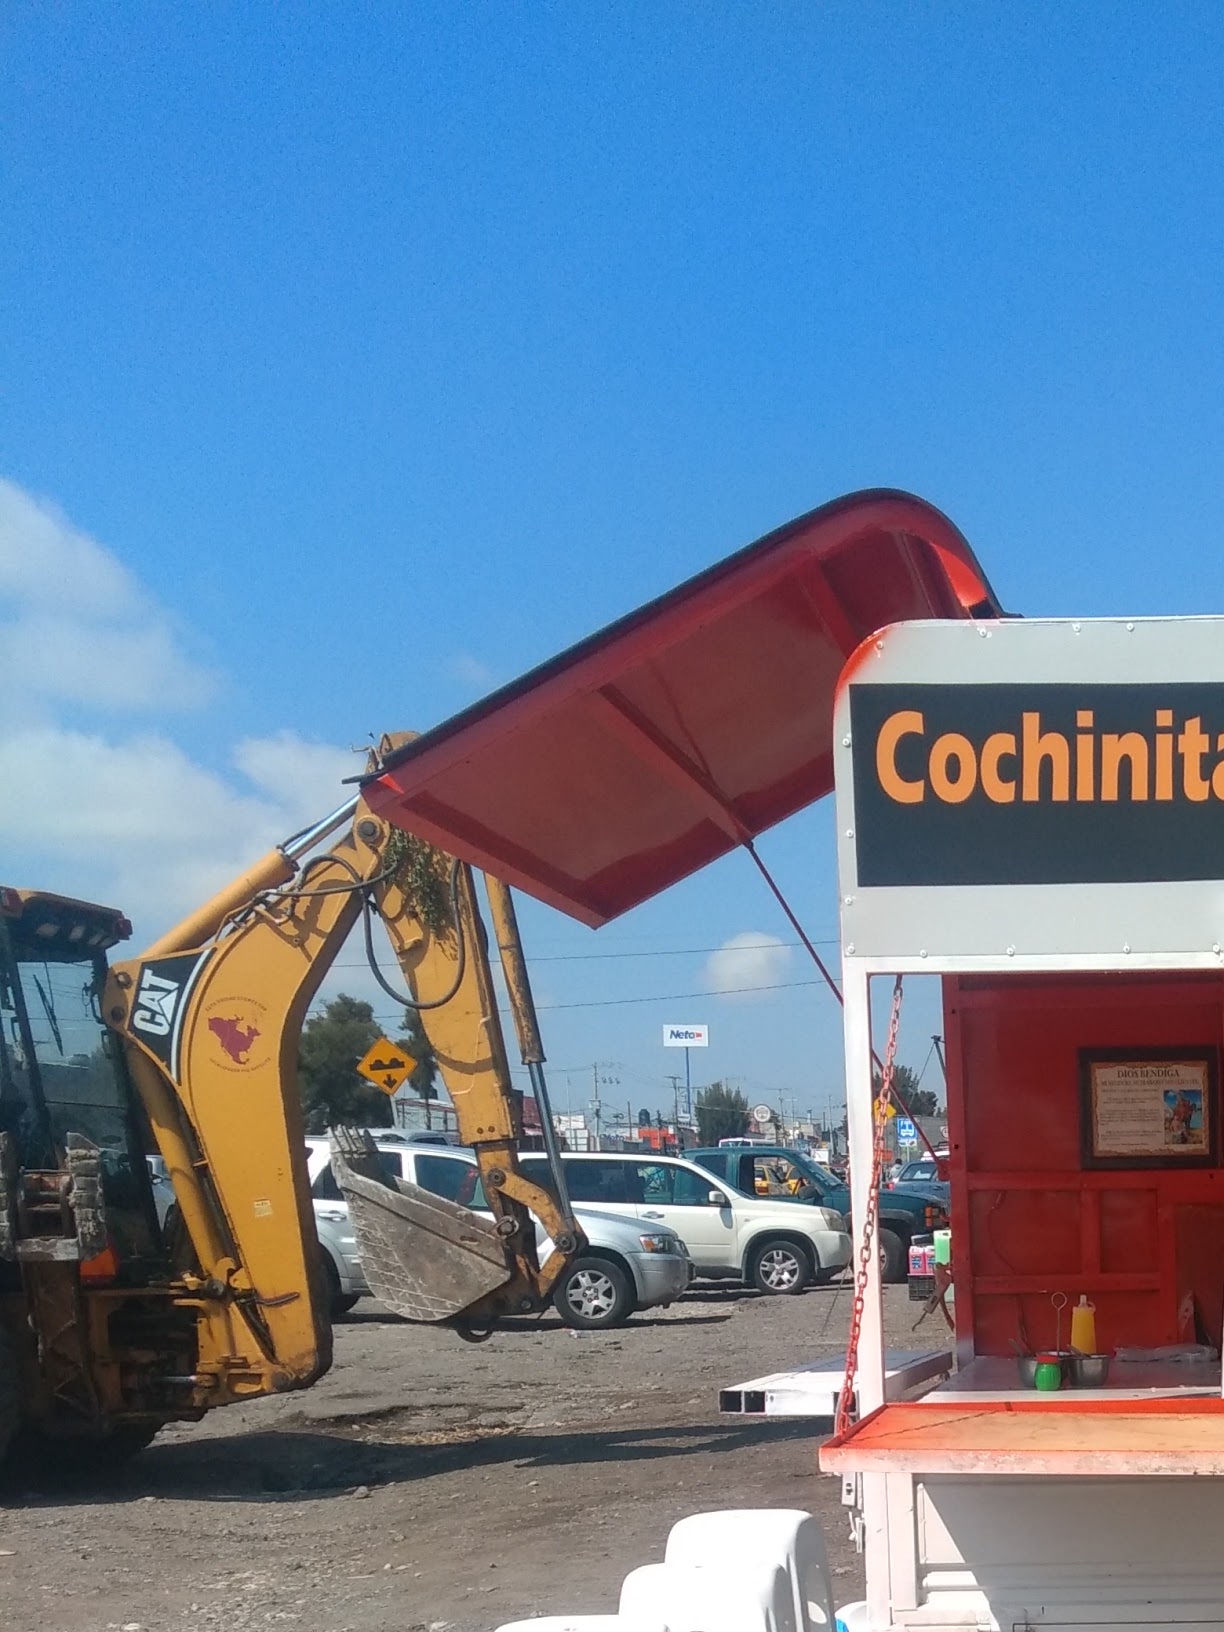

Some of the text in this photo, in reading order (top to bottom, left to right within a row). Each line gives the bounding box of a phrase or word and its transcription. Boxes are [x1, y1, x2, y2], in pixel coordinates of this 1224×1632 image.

[133, 968, 180, 1036] CAT
[669, 1030, 696, 1040] Neto
[1117, 1068, 1180, 1079] DIOS BENDIGA
